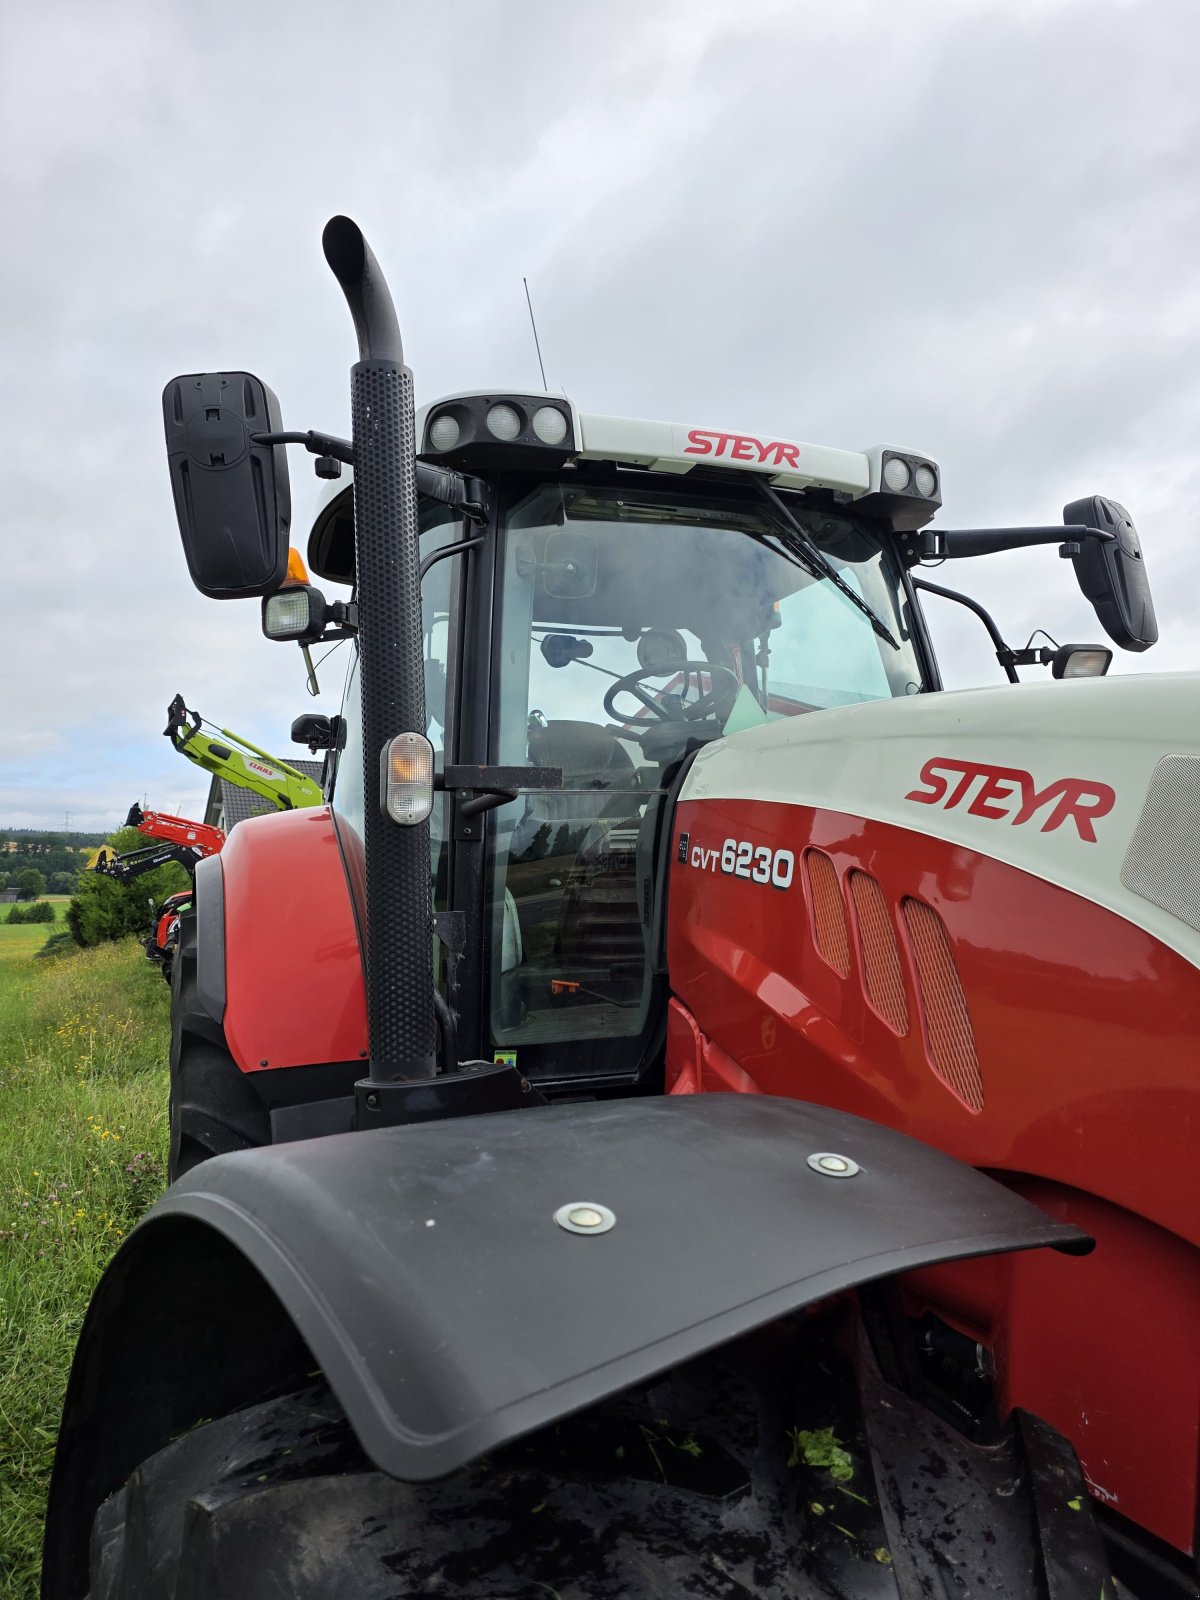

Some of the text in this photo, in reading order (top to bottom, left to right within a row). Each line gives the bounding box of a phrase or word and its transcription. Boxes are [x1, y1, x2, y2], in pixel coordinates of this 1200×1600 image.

[684, 430, 799, 468] STEYR
[249, 762, 273, 776] CLAAS
[905, 757, 1116, 843] STEYR
